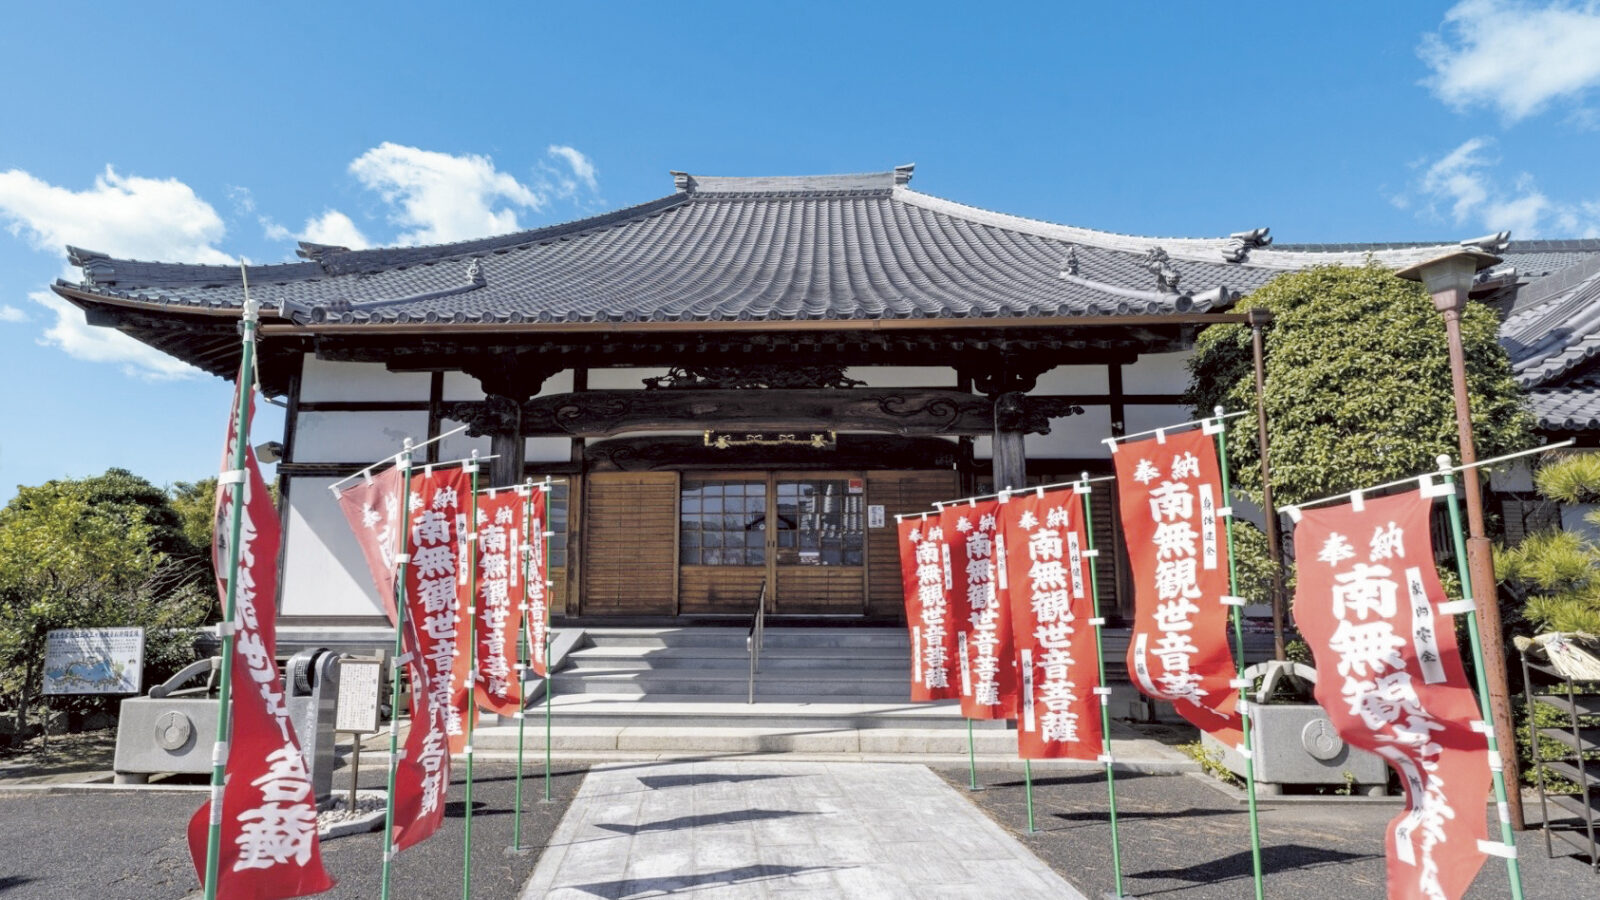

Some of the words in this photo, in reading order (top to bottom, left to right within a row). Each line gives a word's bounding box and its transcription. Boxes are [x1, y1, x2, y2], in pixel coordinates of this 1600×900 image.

[1134, 451, 1200, 485] 奉納
[909, 526, 943, 543] 奉納
[956, 514, 996, 533] 奉納
[1018, 506, 1069, 531] 奉納
[1317, 521, 1405, 567] 奉納
[916, 540, 950, 689] 南無観世音菩薩
[966, 531, 1001, 706] 南無観世音菩薩
[1028, 528, 1080, 743] 南無観世音菩薩
[1411, 580, 1437, 663] 家内安全
